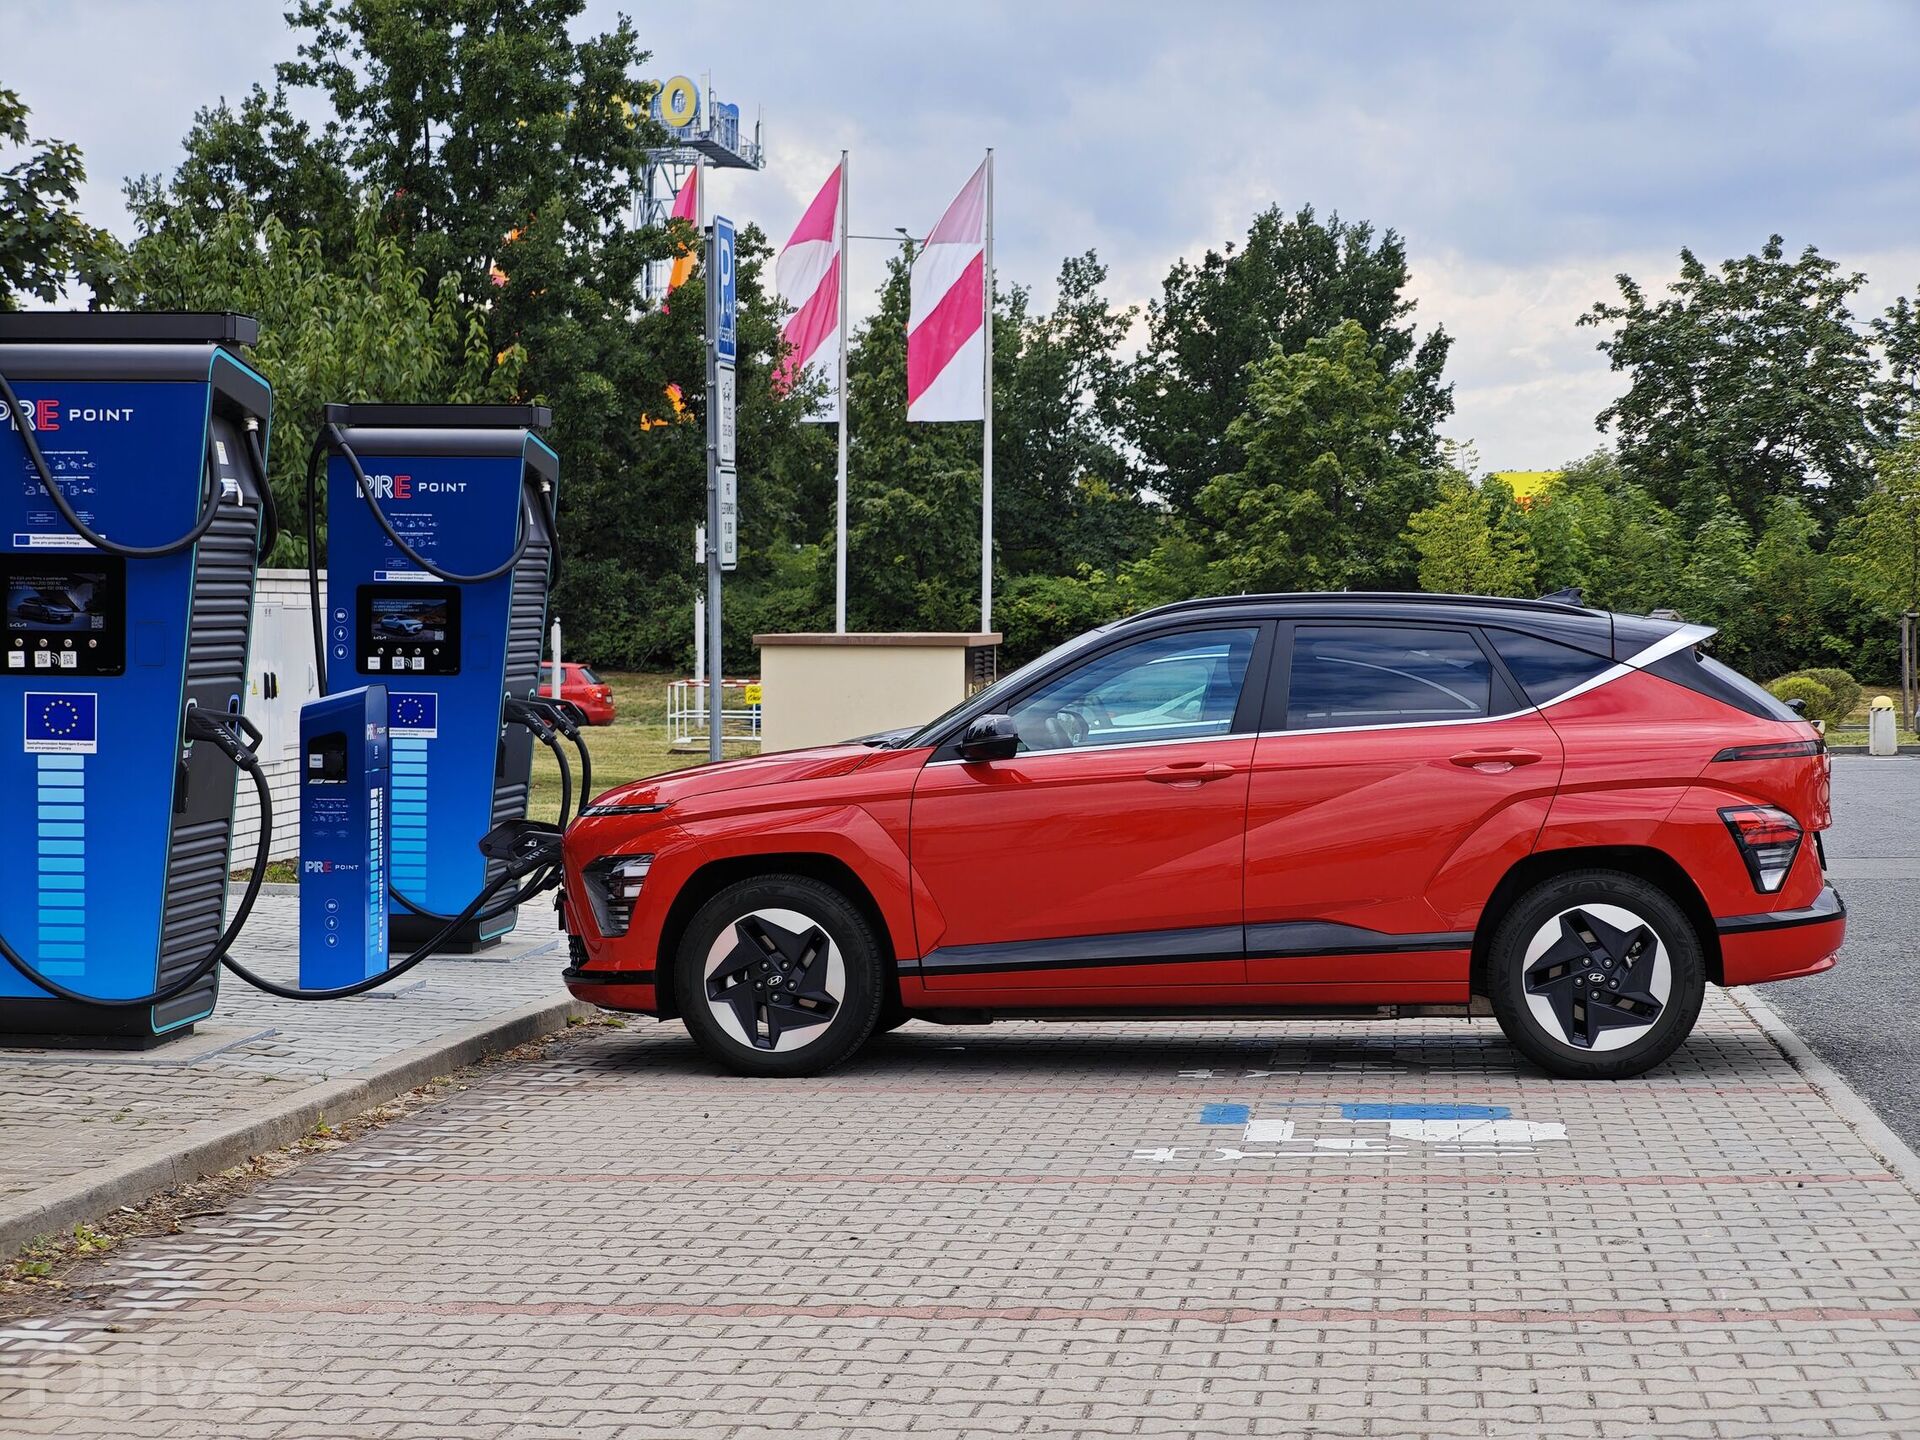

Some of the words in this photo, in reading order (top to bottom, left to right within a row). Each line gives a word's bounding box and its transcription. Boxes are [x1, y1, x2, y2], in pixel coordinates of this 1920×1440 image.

[720, 237, 731, 314] P
[69, 409, 134, 421] POINT
[356, 475, 412, 499] PRE
[418, 482, 467, 493] POINT
[213, 728, 238, 745] HPC
[525, 847, 549, 860] HPC
[305, 861, 333, 873] PRE
